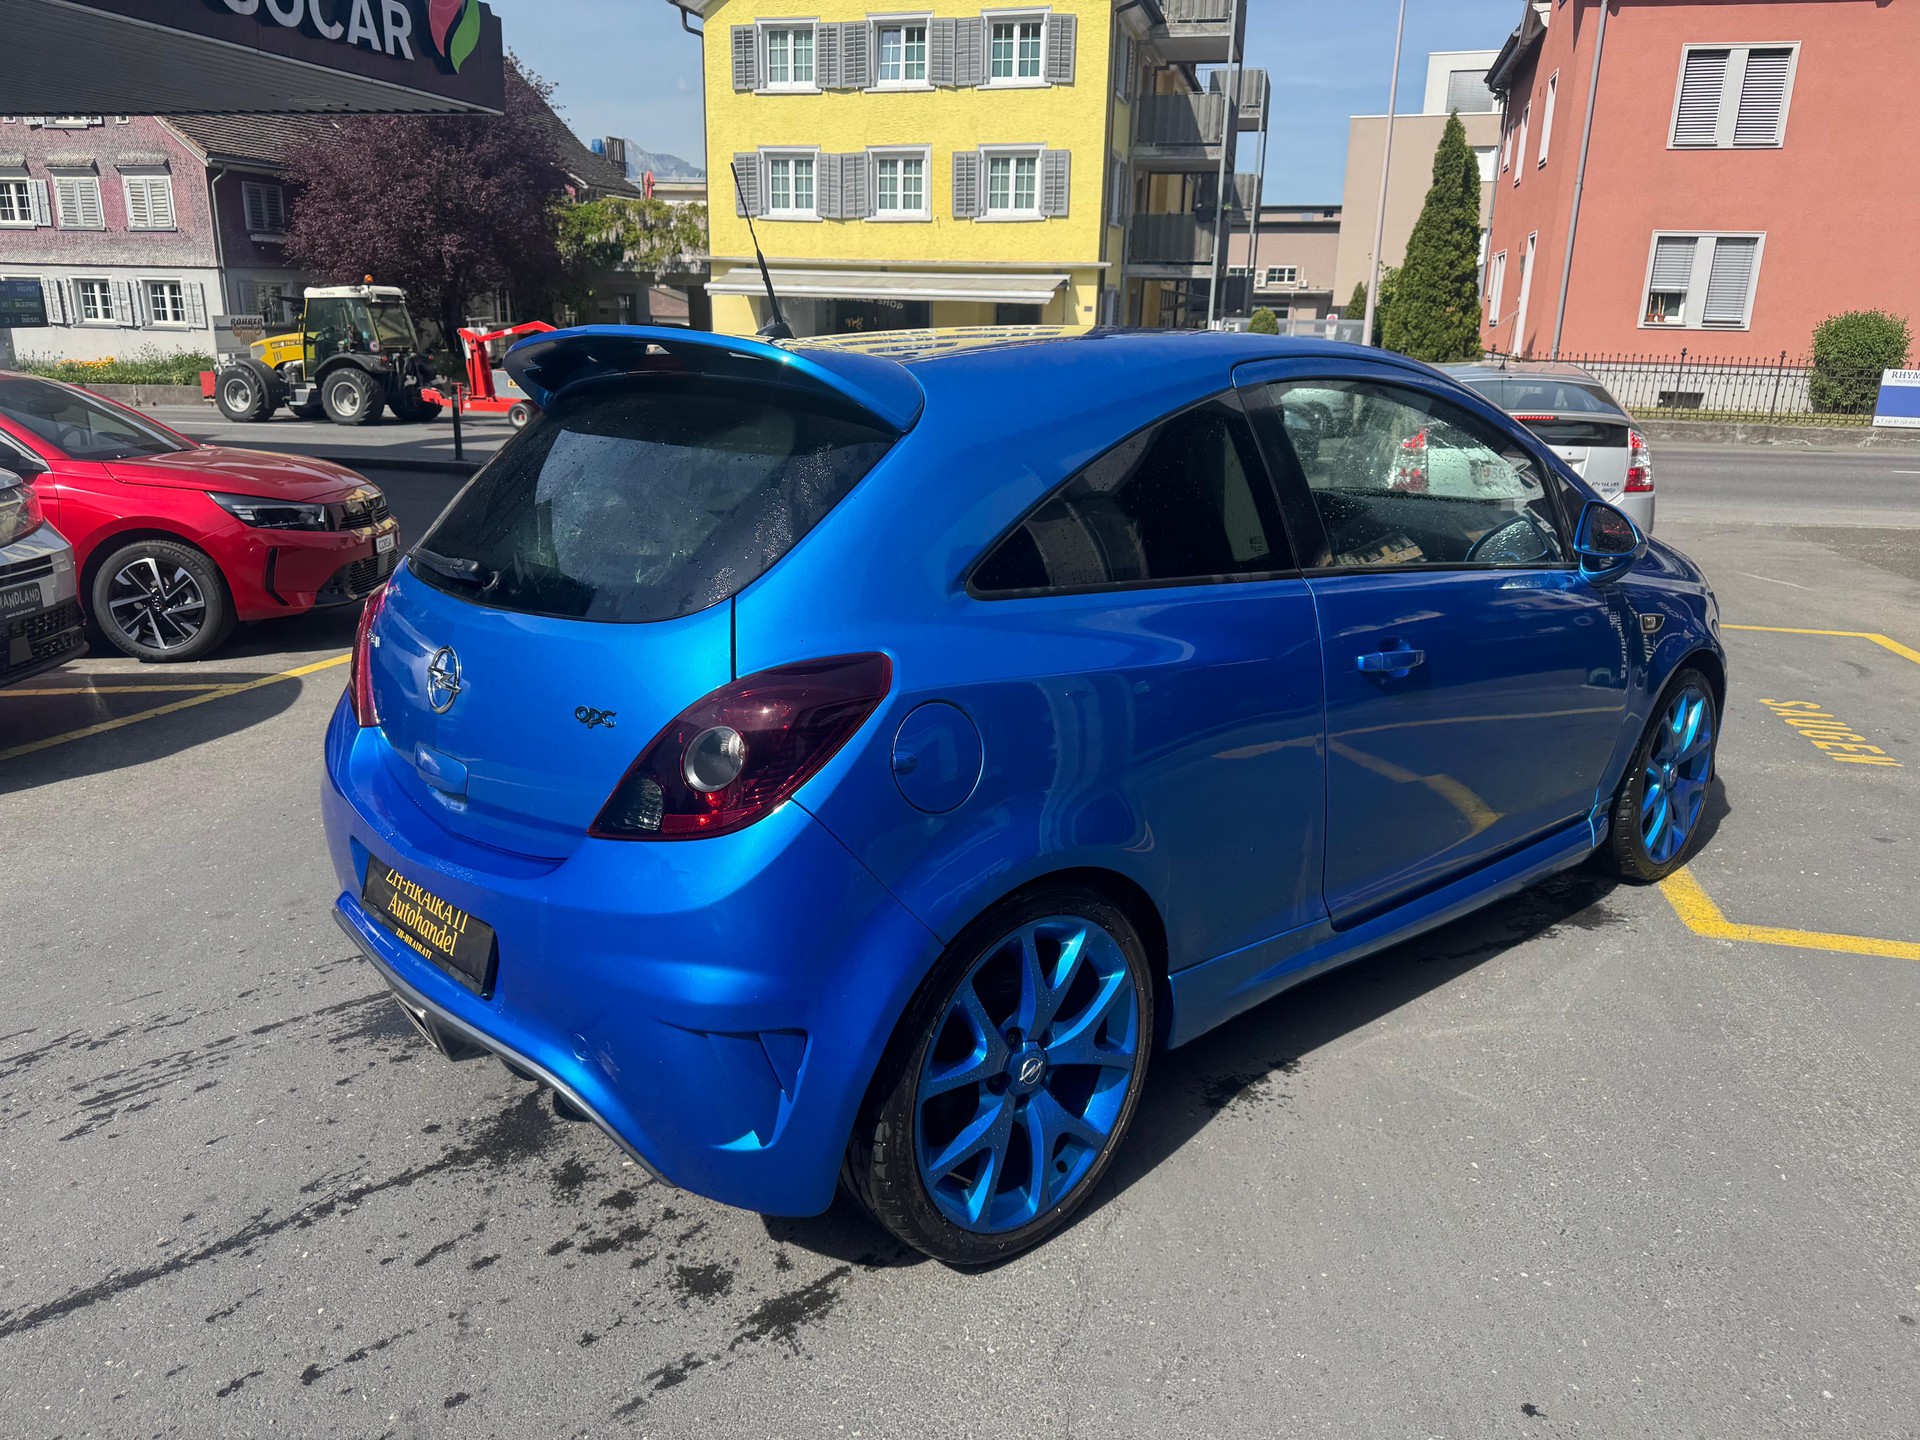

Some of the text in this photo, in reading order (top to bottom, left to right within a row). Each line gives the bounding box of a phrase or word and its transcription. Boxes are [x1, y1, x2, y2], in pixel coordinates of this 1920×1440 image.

[222, 0, 415, 60] OCAR
[877, 299, 903, 310] SHOP
[162, 548, 204, 576] MICHELIN
[574, 705, 617, 729] OPC
[1758, 698, 1905, 767] SAUGEN
[387, 891, 458, 957] Autohandel
[395, 927, 433, 960] ZH-HRAIRATI
